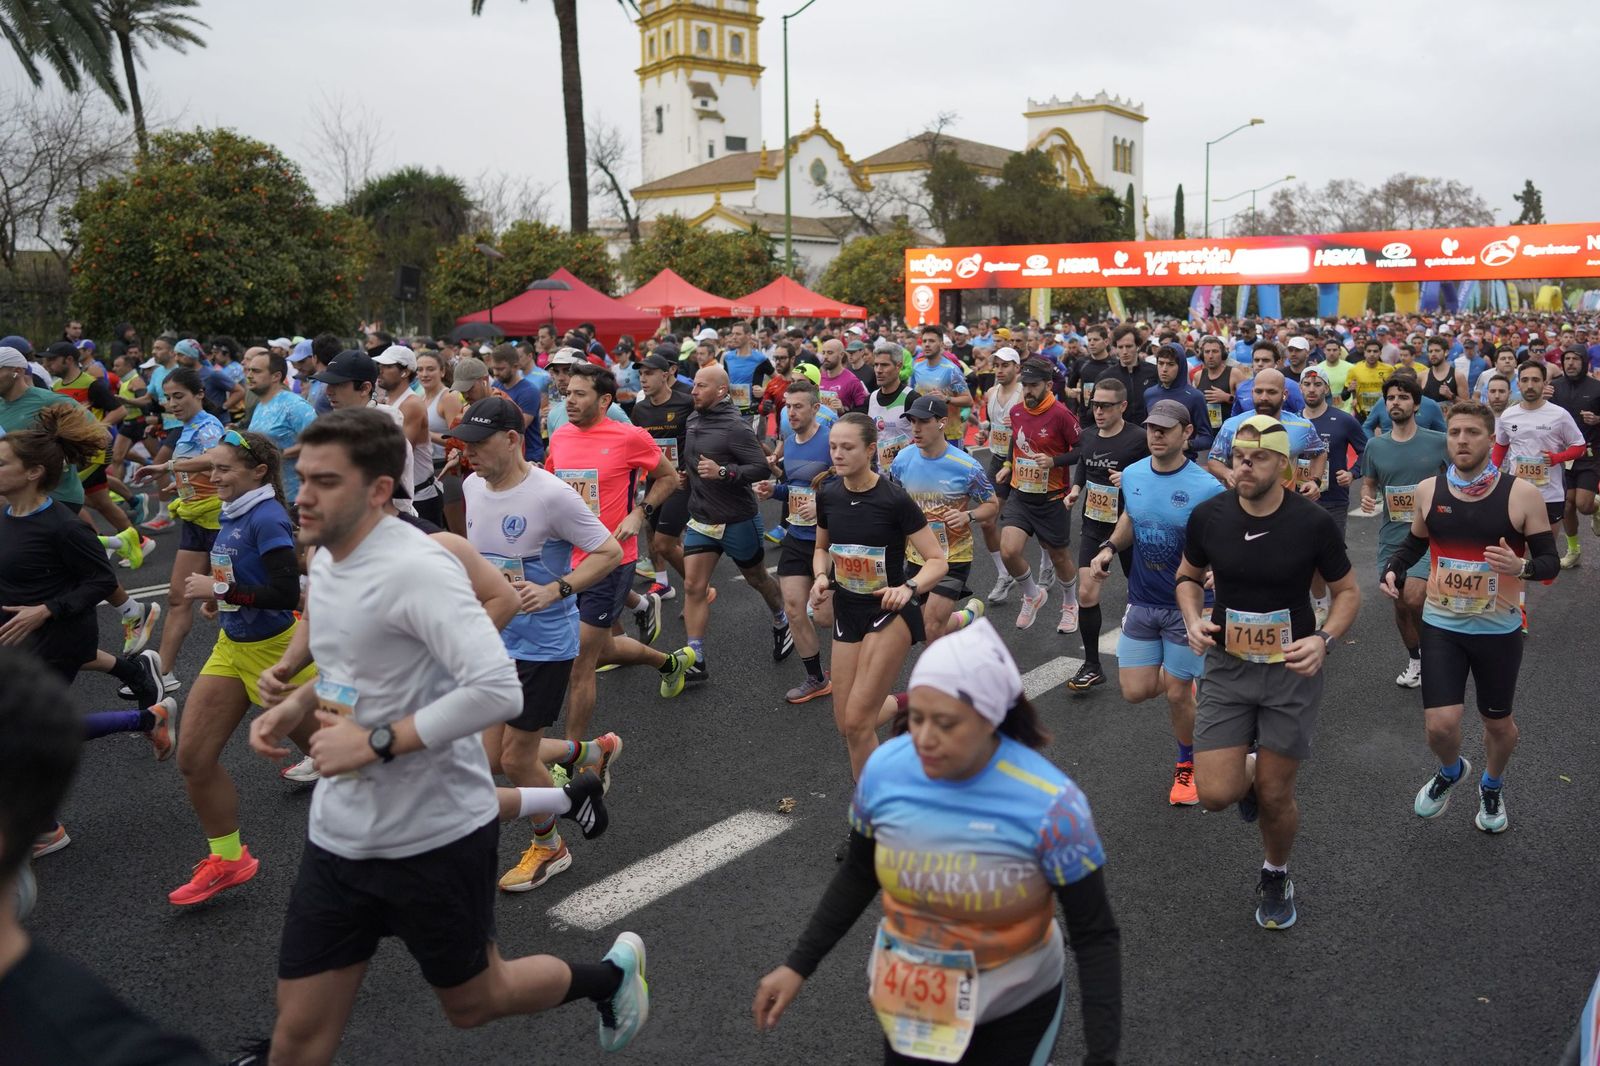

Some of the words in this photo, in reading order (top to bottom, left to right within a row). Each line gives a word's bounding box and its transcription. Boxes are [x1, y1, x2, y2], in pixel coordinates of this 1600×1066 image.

[1019, 466, 1040, 479] 6115
[1519, 465, 1541, 475] 5135
[842, 556, 875, 574] 7991
[1444, 572, 1483, 591] 4947
[1234, 626, 1275, 646] 7145
[883, 962, 948, 1006] 4753
